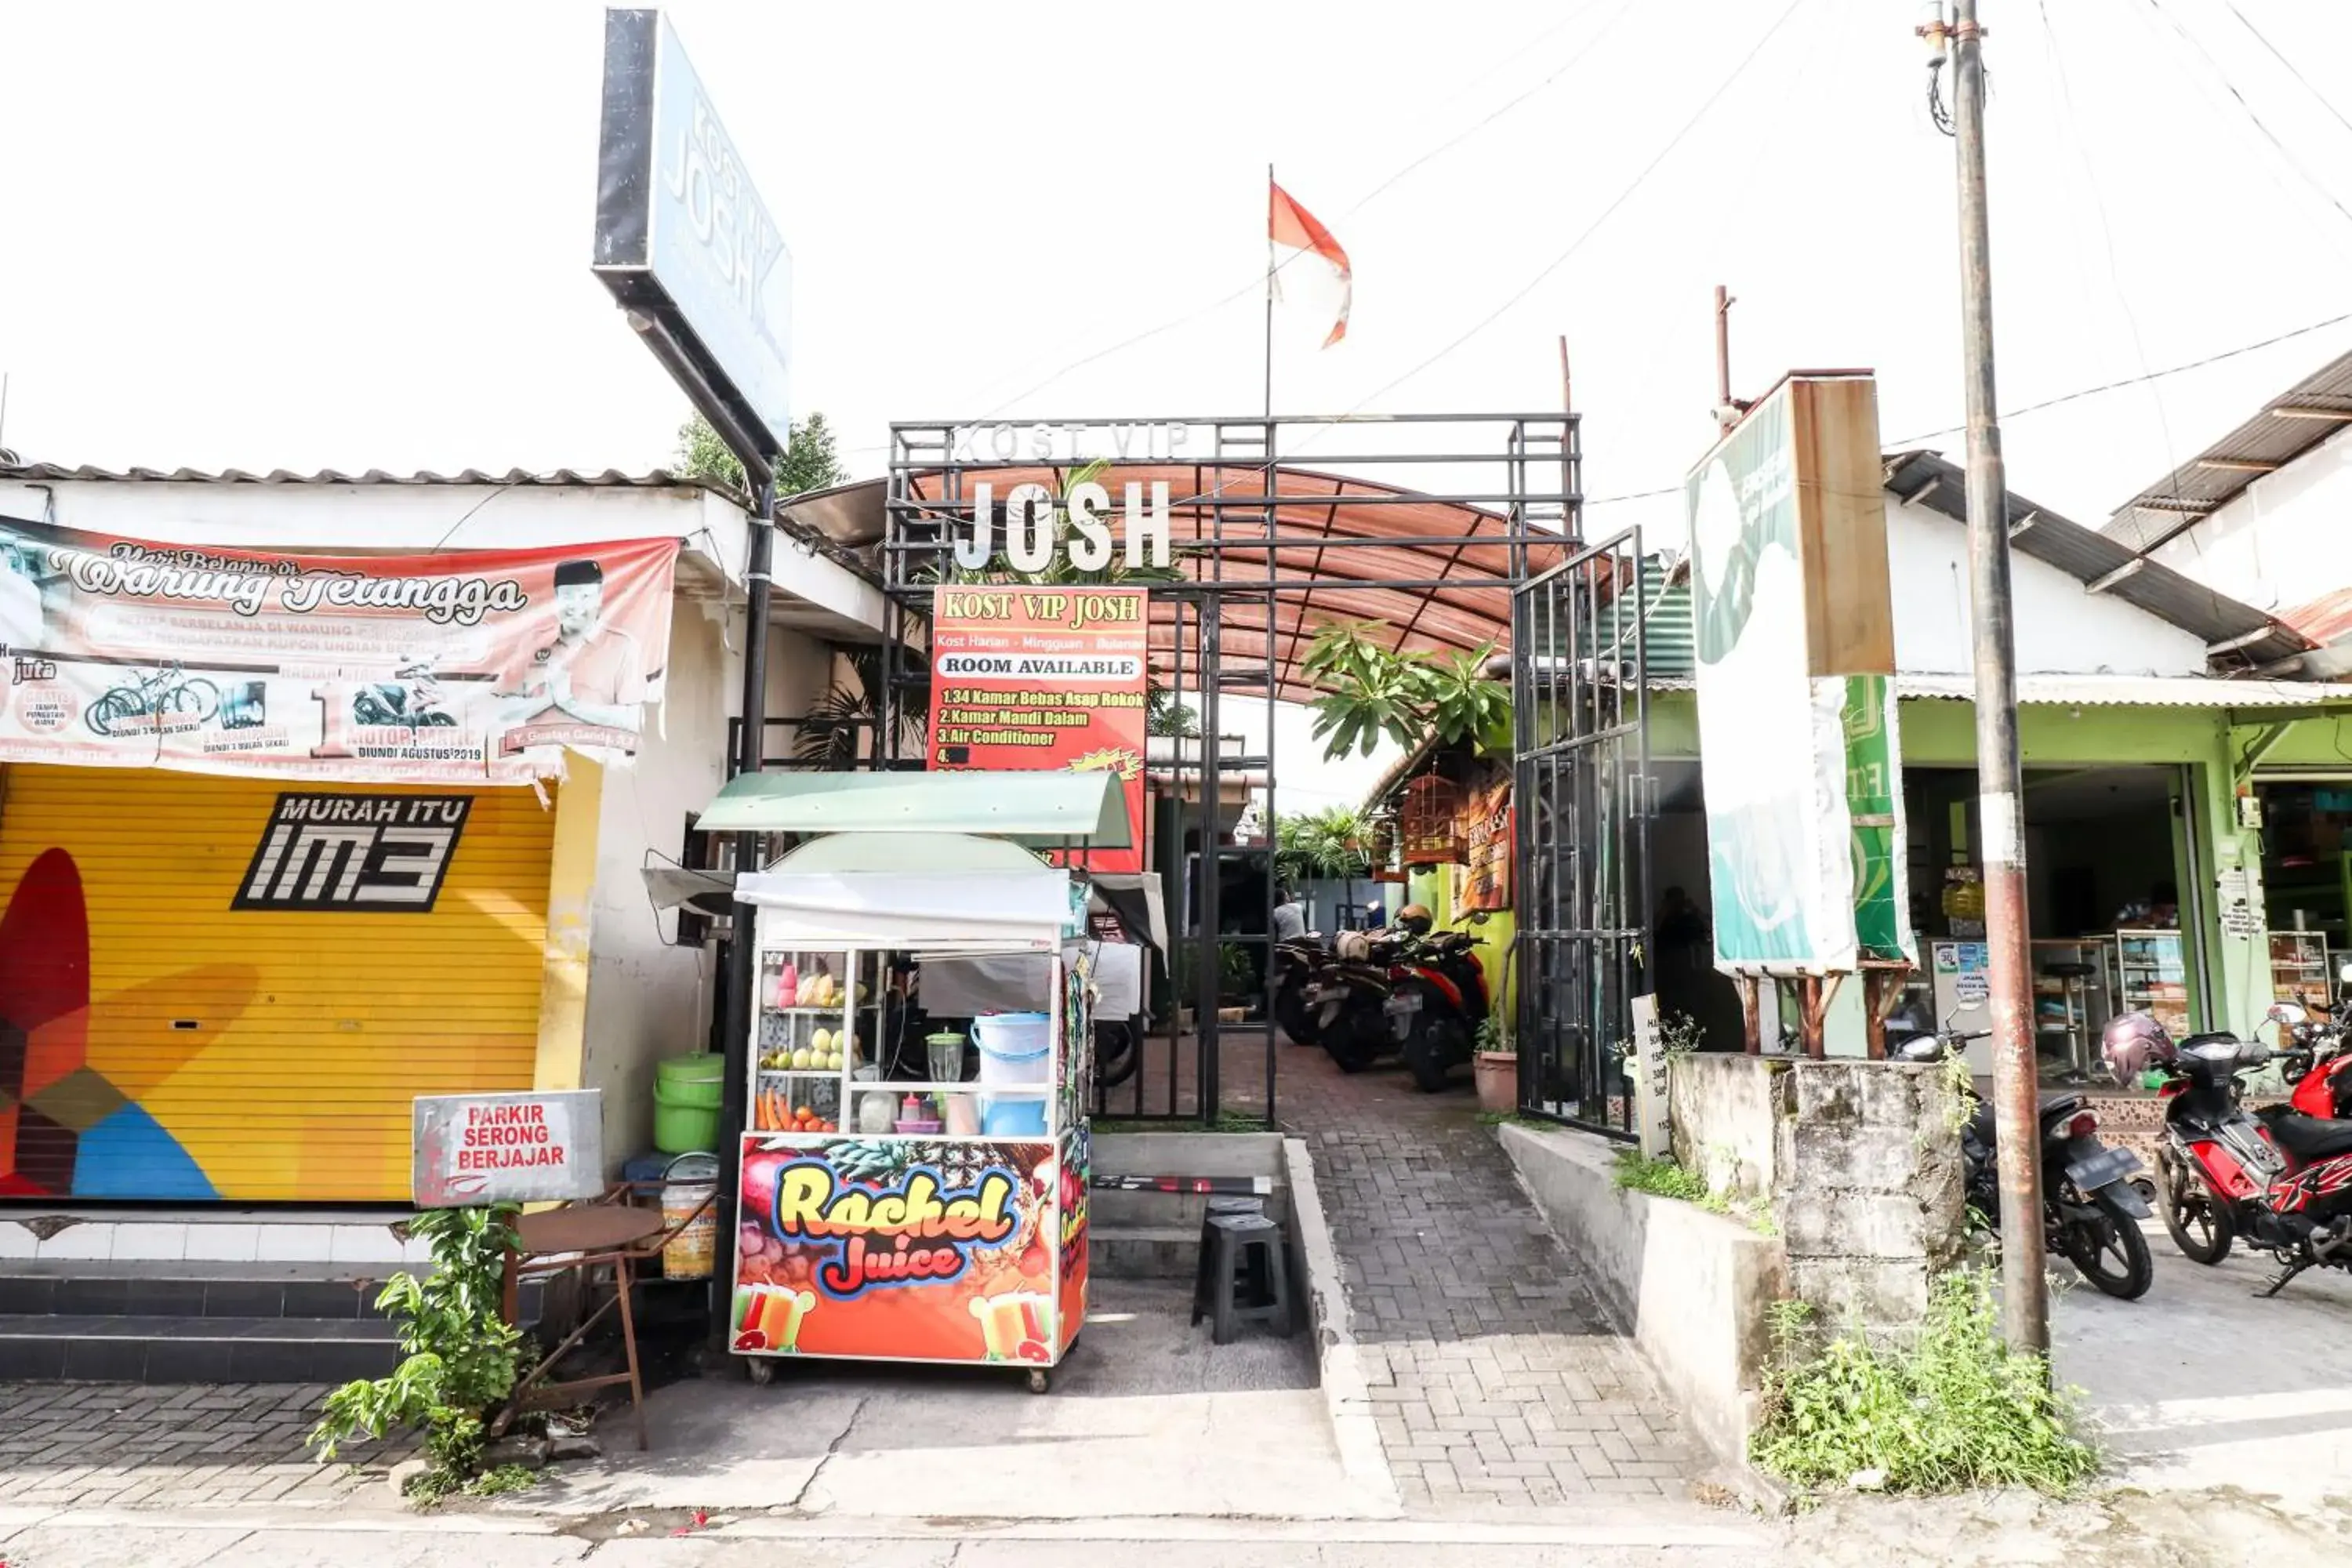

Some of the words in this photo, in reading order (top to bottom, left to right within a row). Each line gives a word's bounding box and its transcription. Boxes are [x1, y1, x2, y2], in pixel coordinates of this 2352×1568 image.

[663, 125, 757, 320] JOSH
[952, 422, 1087, 461] KOST
[1109, 422, 1191, 460] VIP
[953, 481, 1171, 573] JOSH
[278, 560, 300, 575] di
[49, 550, 275, 616] Warung
[281, 569, 528, 626] Tetangga
[942, 592, 1014, 620] KOST
[1022, 593, 1067, 621] VIP
[1069, 595, 1140, 630] JOSH
[286, 622, 354, 637] WARUNG
[937, 635, 965, 648] Kost
[1022, 637, 1083, 652] Mingguan
[1095, 637, 1145, 650] Bulanan
[13, 657, 57, 686] juta
[945, 657, 1013, 673] ROOM
[1018, 659, 1134, 675] AVAILABLE
[942, 688, 970, 705] 1.34
[972, 689, 1018, 706] Kamar
[1019, 690, 1063, 707] Bebas
[1064, 691, 1098, 709] Asap
[1102, 691, 1145, 707] Rokok
[939, 709, 998, 726] 2.Kamar
[999, 710, 1043, 726] Mandi
[1044, 711, 1089, 727] Dalam
[972, 729, 1056, 746] Conditioner
[358, 746, 398, 759] DIUNDI
[401, 748, 450, 760] AGUSTUS
[278, 797, 401, 822] MURAH
[406, 800, 465, 823] ITU
[245, 824, 455, 903] IM3
[467, 1104, 544, 1126] PARKIR
[463, 1123, 549, 1147] SERONG
[457, 1145, 564, 1170] BERJAJAR
[779, 1163, 1014, 1243] Rachel
[820, 1232, 964, 1294] Juice
